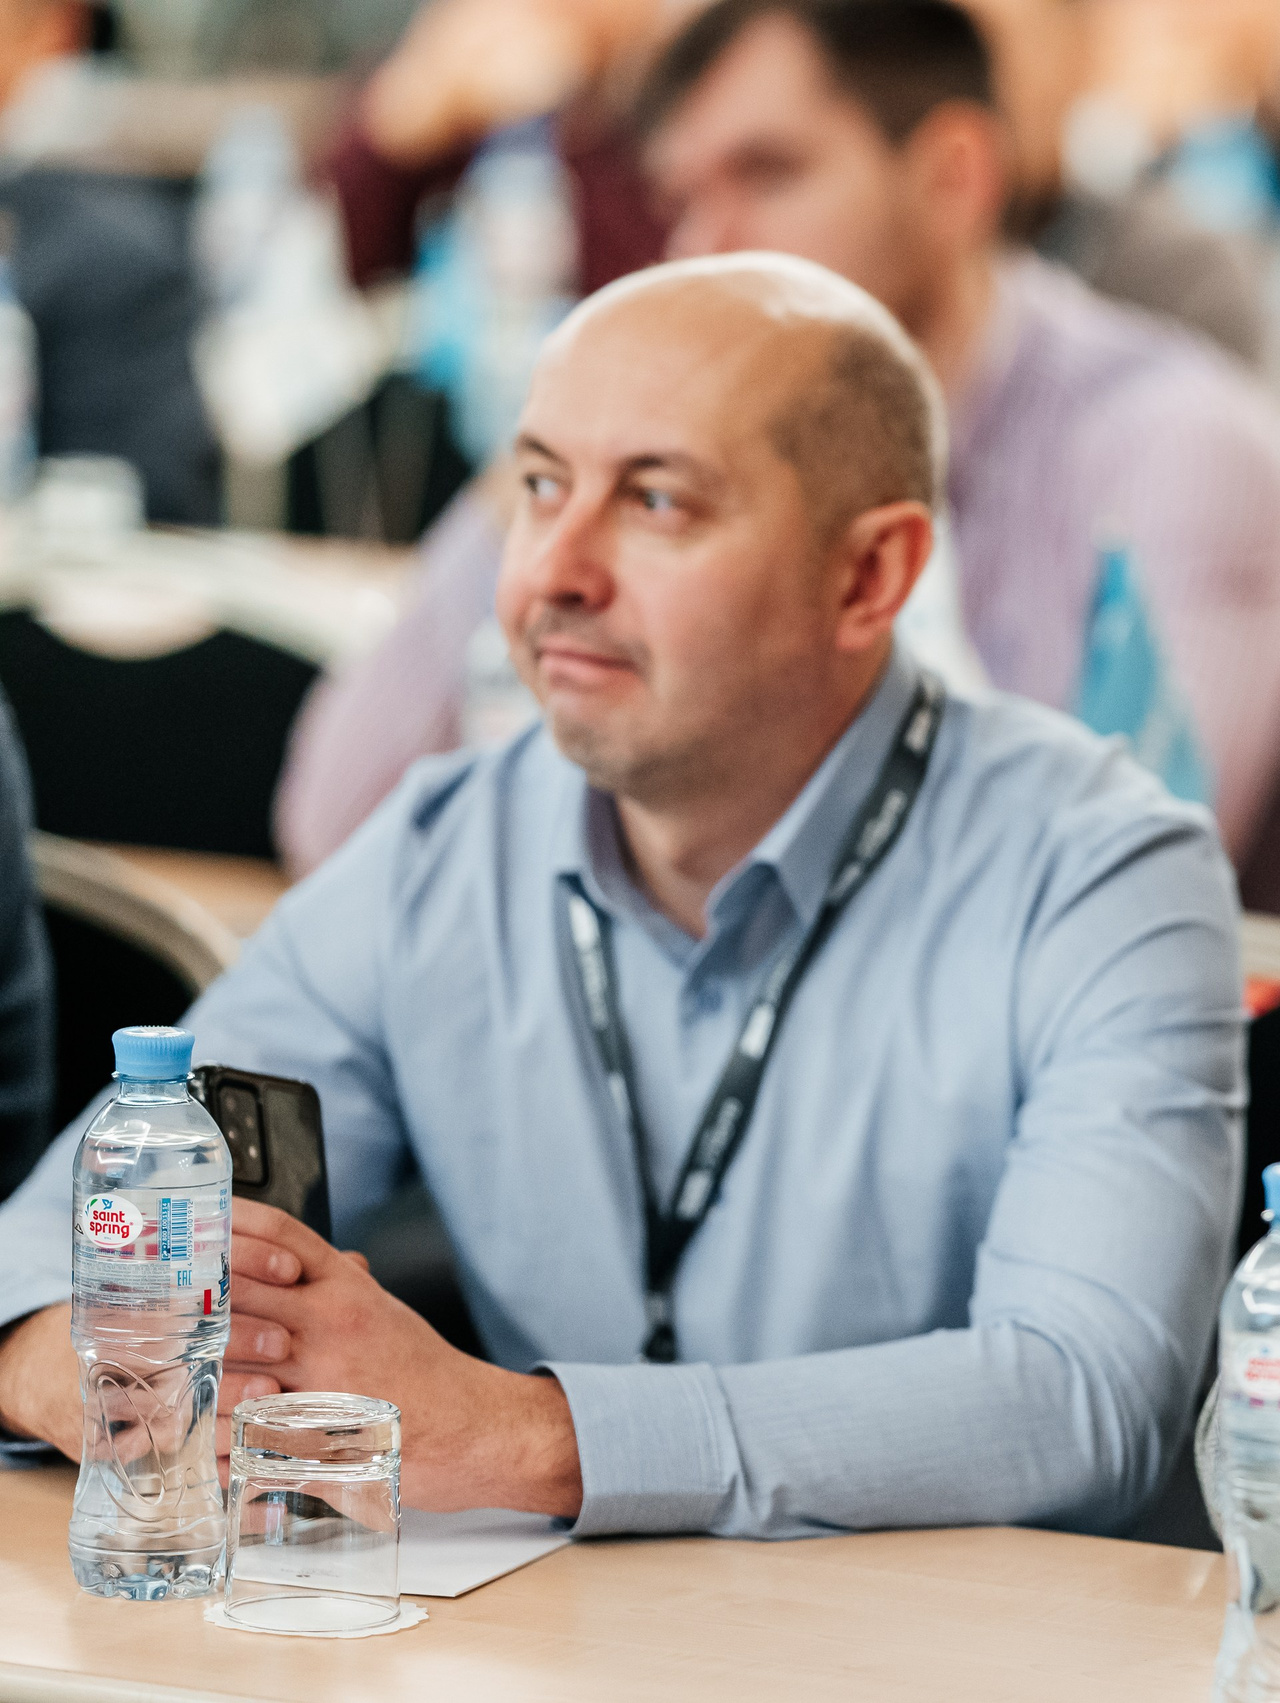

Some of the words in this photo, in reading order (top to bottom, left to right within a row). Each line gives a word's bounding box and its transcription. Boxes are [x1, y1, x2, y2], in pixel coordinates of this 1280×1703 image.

[93, 1210, 125, 1223] saint
[90, 1221, 129, 1238] spring
[177, 1270, 192, 1286] EAC
